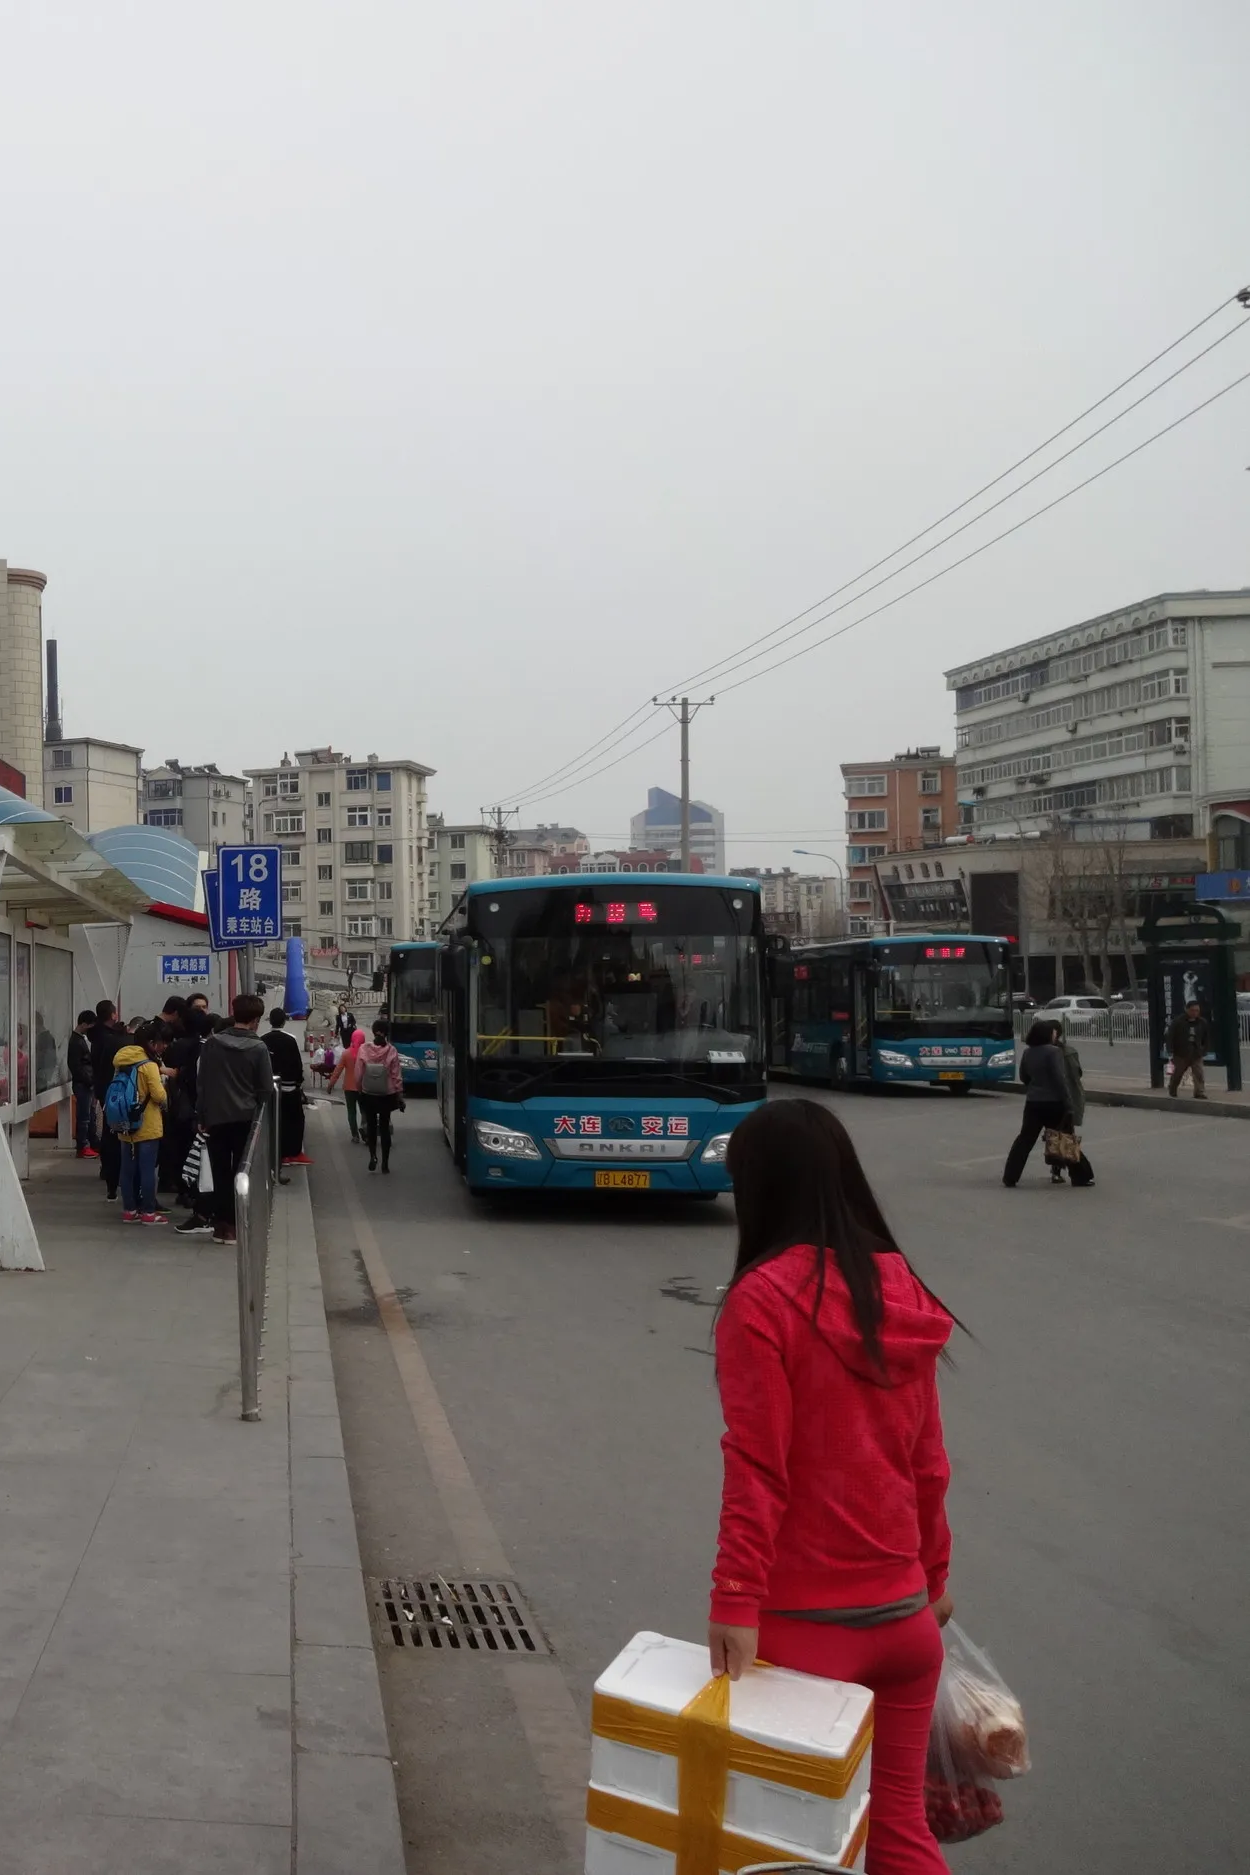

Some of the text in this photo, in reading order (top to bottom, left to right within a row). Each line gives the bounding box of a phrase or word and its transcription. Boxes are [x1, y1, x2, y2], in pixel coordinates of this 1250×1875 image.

[230, 853, 269, 883] 18
[238, 887, 263, 911] 路
[226, 916, 275, 935] 乘车站台
[554, 1115, 689, 1136] 大连 交运
[578, 1142, 666, 1153] ANKAI
